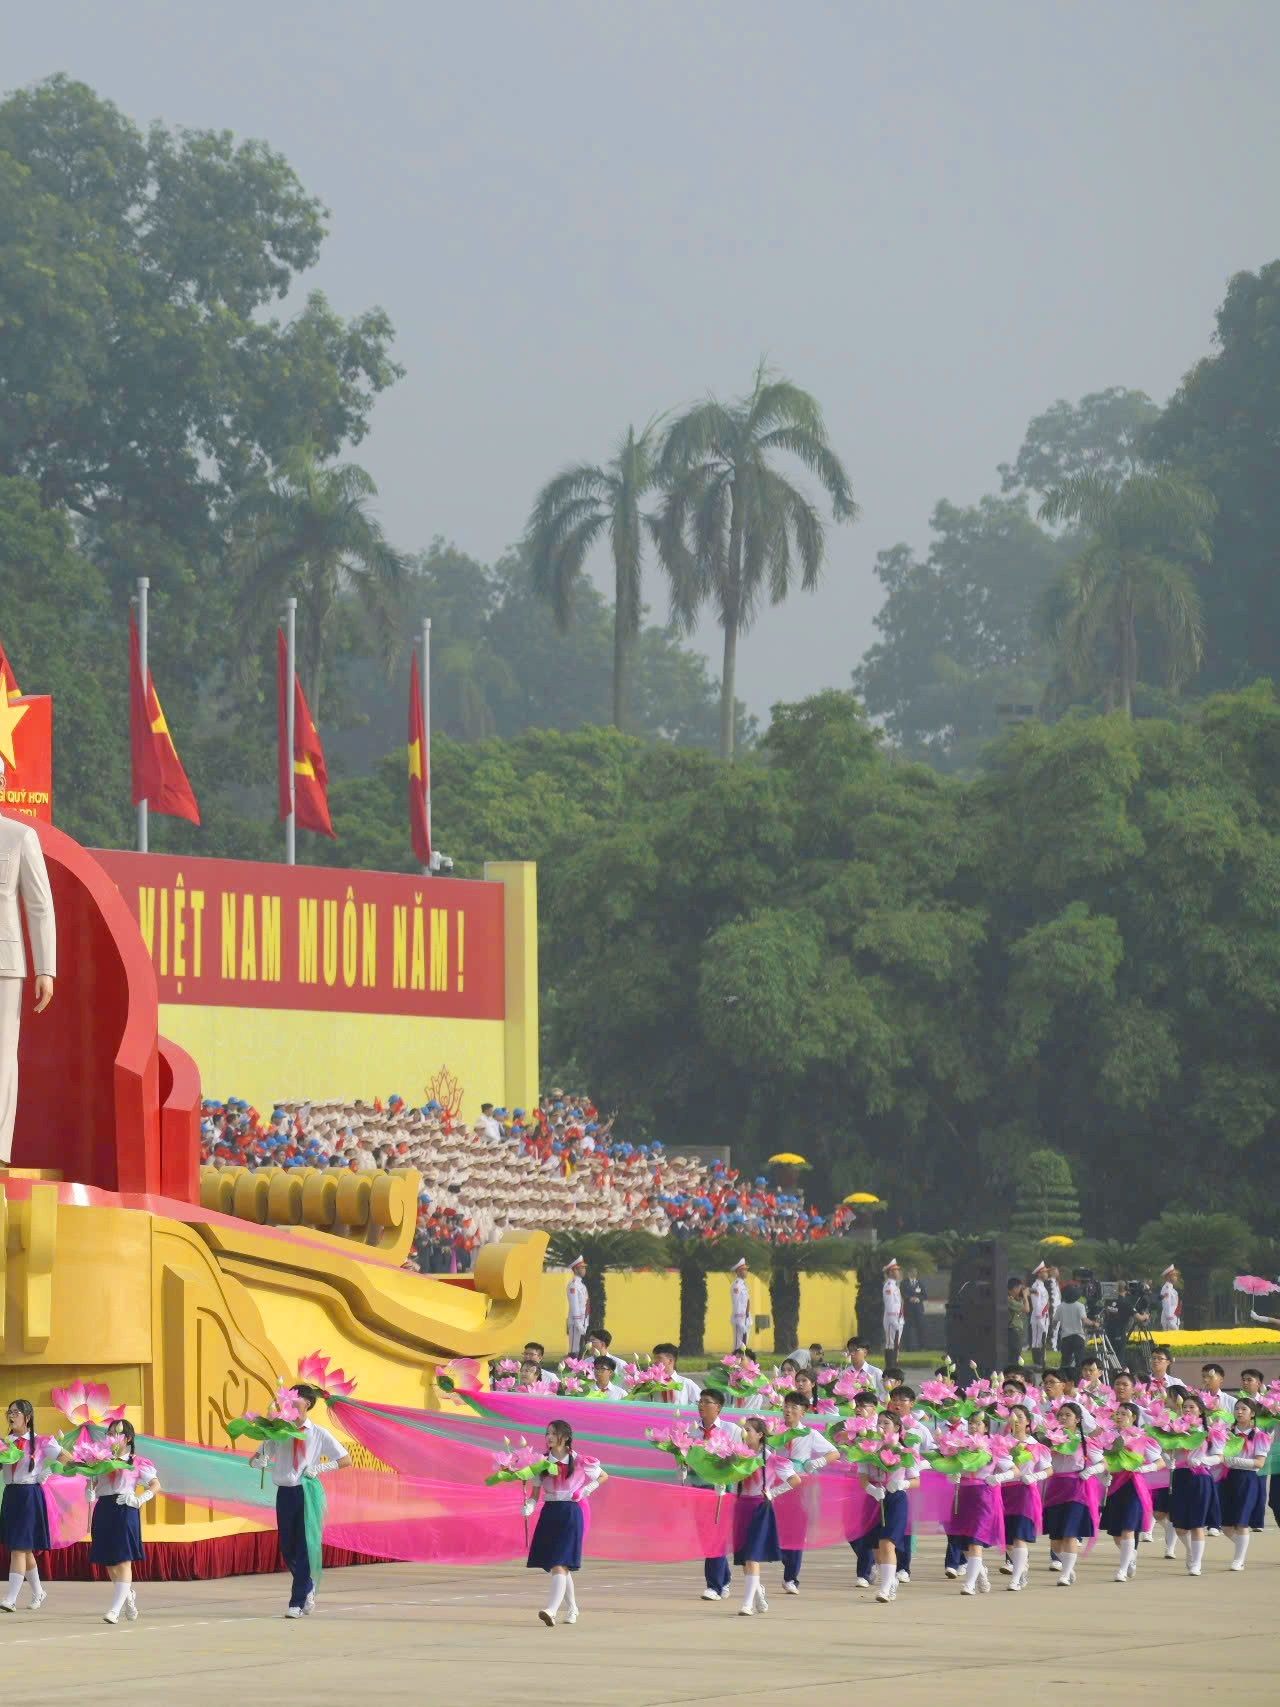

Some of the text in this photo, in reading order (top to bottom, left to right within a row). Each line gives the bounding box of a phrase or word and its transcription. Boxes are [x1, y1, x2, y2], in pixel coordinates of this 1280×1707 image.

[138, 872, 205, 994] VIỆT
[221, 892, 281, 982] NAM
[299, 886, 377, 988] MUÔN
